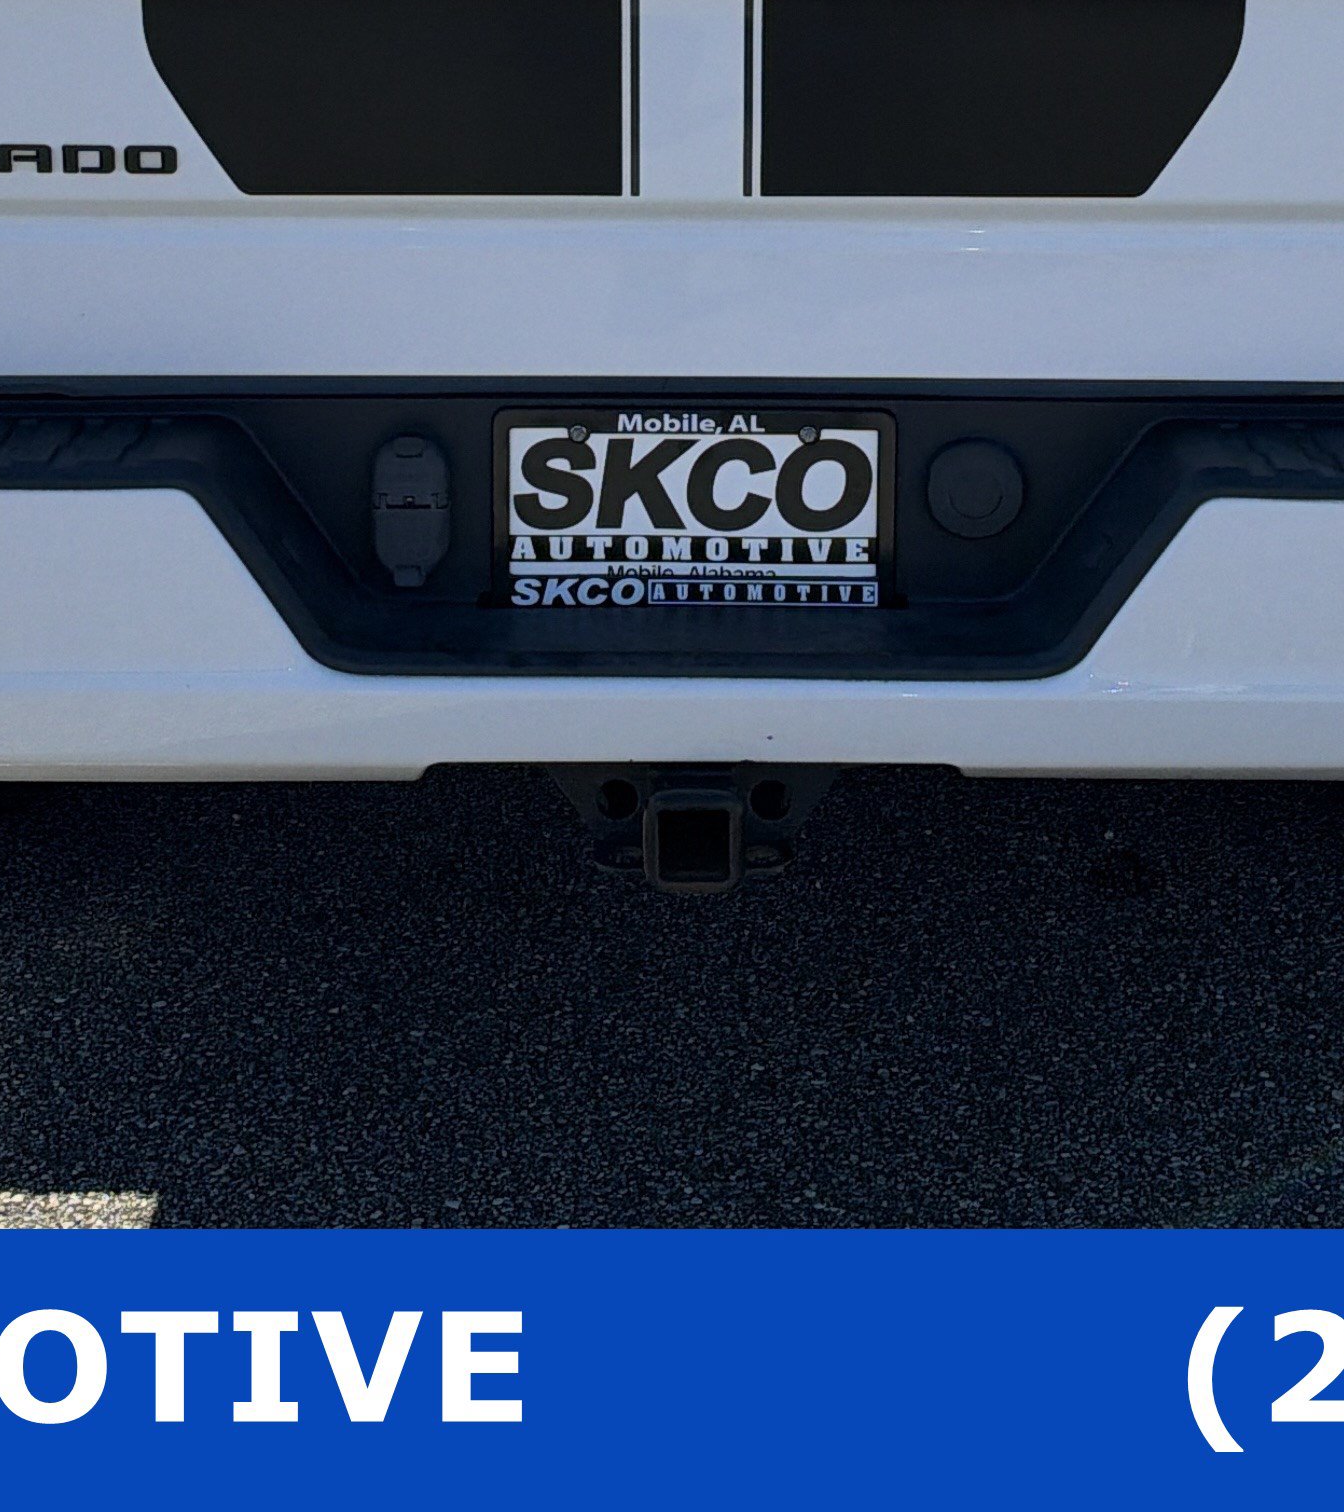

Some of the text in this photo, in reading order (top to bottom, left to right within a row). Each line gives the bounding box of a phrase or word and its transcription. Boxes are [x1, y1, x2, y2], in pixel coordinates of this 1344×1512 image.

[617, 414, 766, 434] Mobile, AL
[513, 437, 873, 533] SKCO
[511, 536, 869, 563] AUTOMOTIVE
[510, 578, 876, 606] SKCO AUTOMOTIVE
